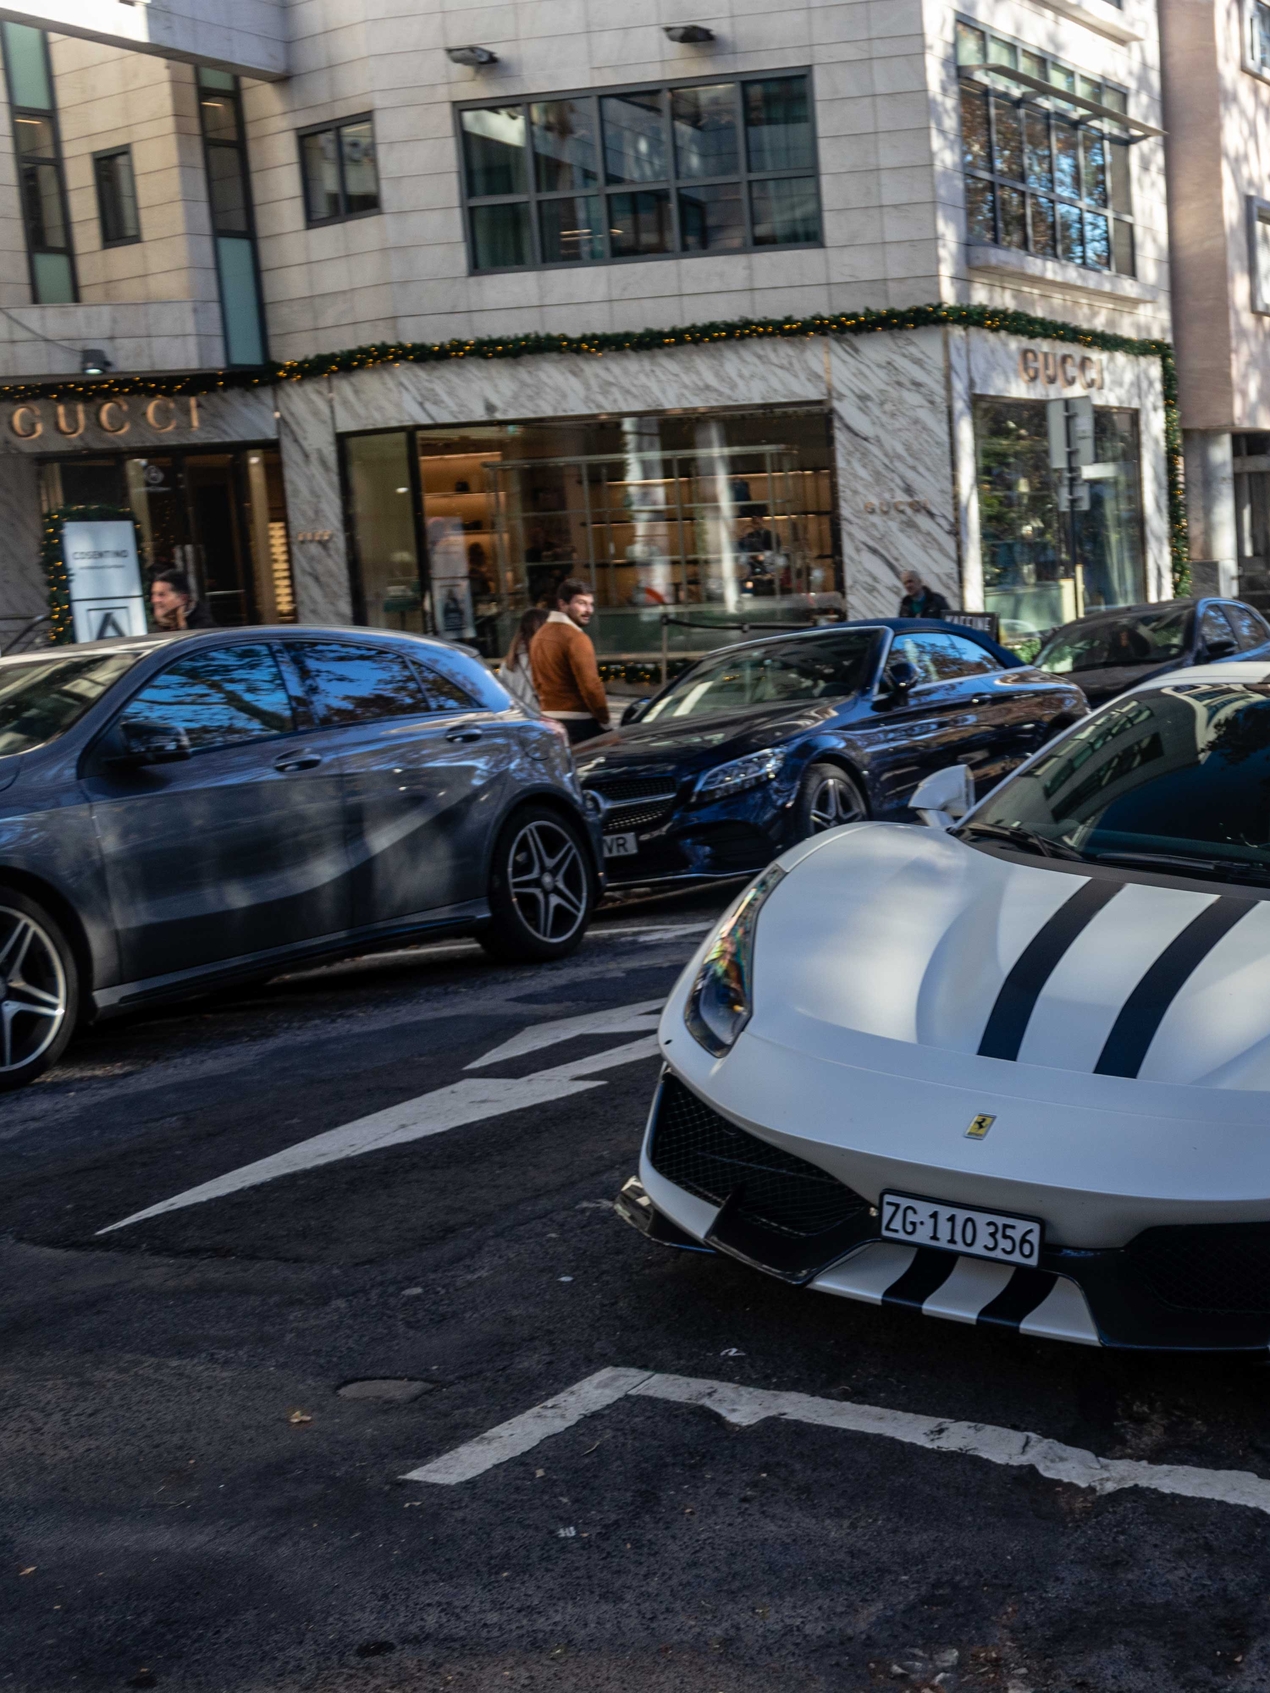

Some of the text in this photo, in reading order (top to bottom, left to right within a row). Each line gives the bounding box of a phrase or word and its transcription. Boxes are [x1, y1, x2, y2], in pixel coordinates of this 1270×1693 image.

[1019, 348, 1104, 390] GUCCI
[12, 397, 199, 440] GUCCI
[983, 1220, 1035, 1259] 356
